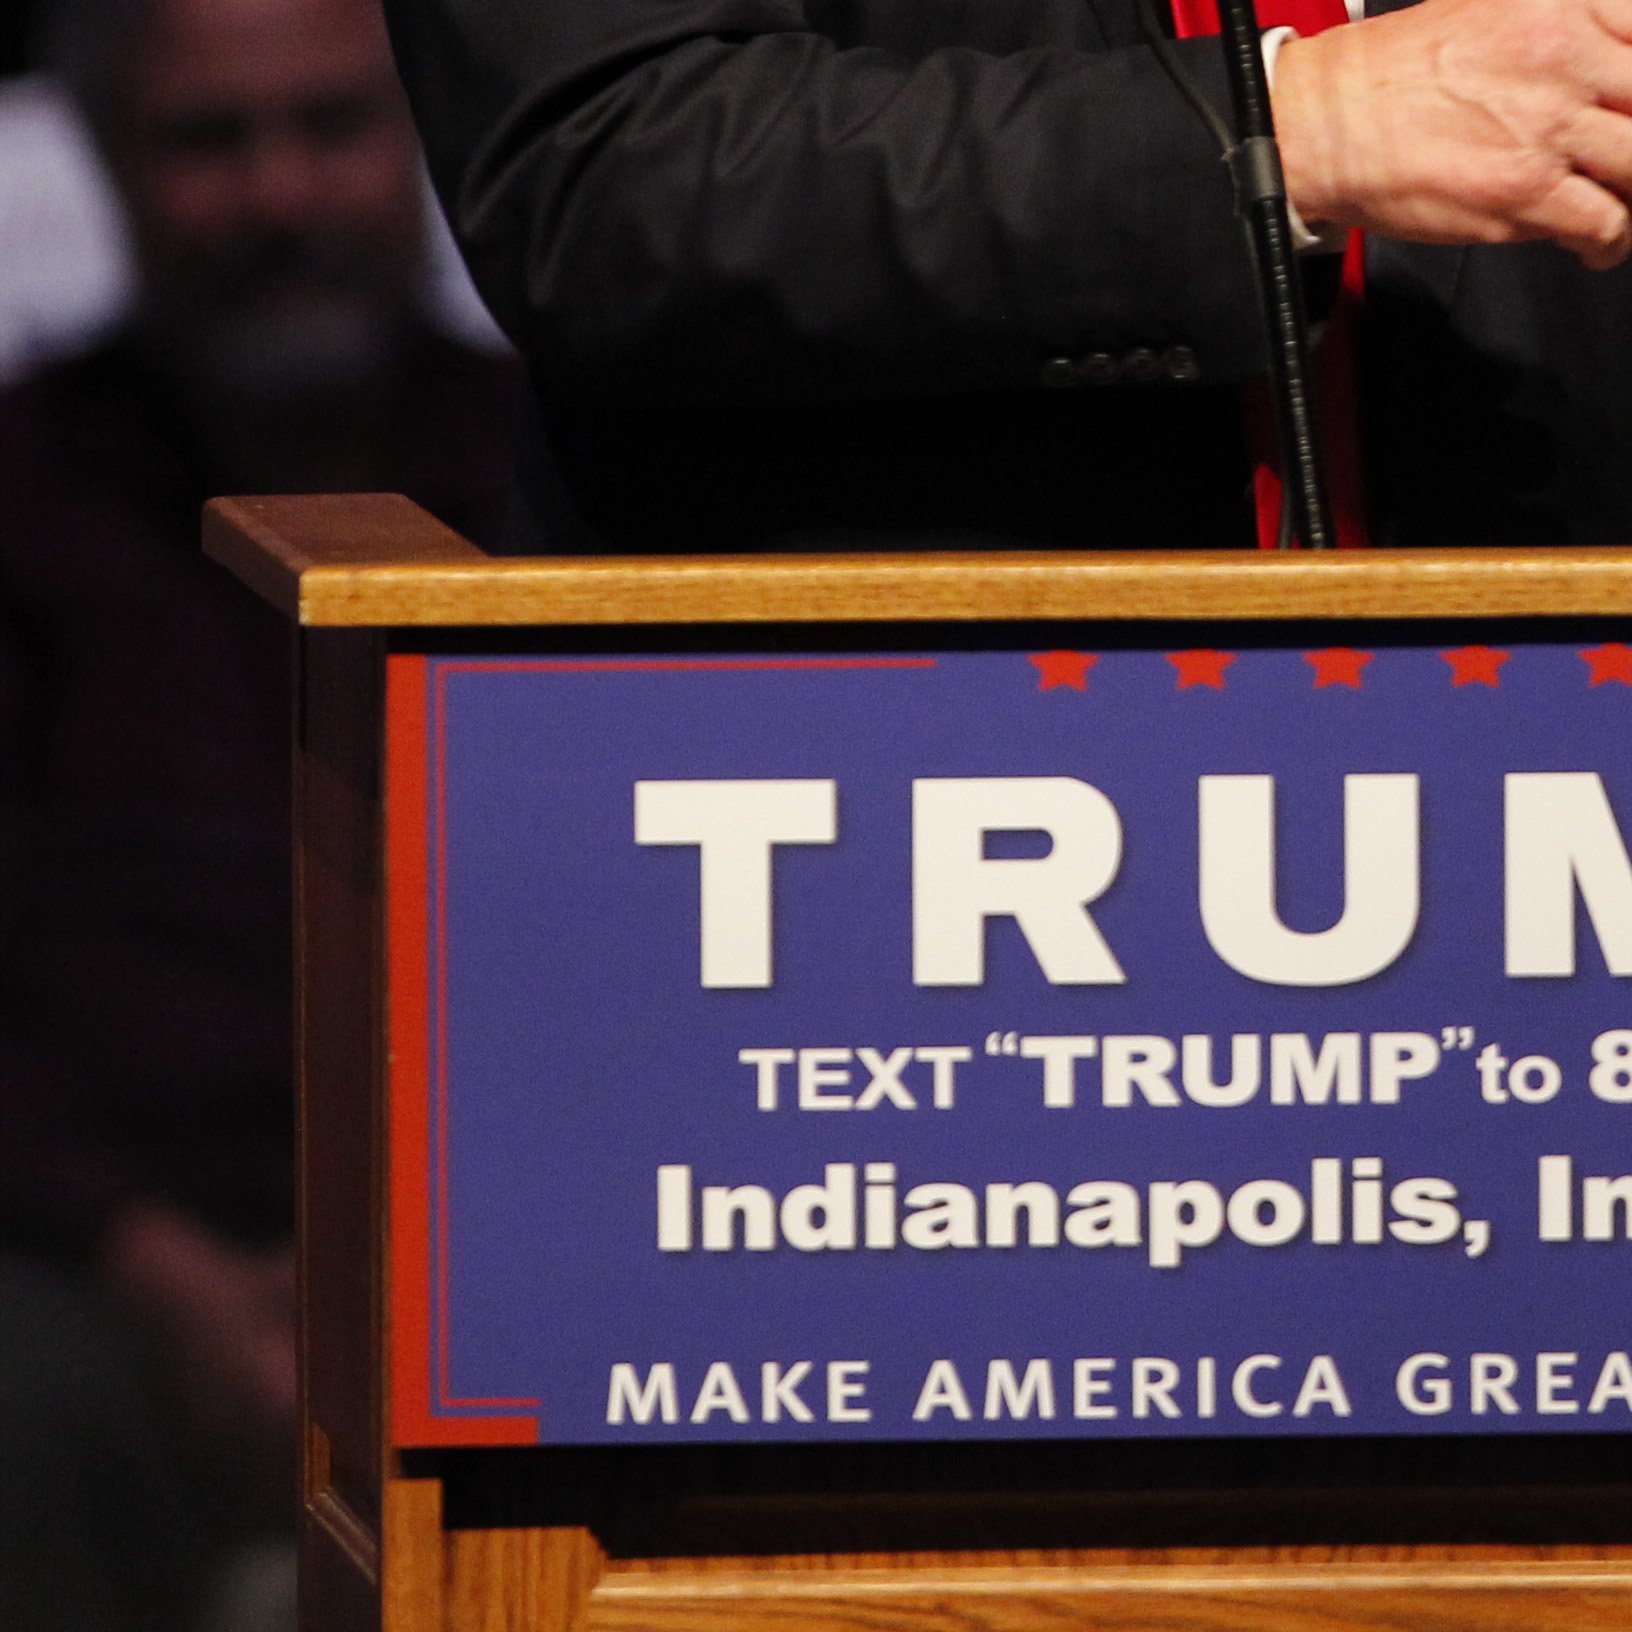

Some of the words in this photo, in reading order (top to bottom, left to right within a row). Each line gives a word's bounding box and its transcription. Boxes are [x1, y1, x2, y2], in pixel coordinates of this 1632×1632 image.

[737, 1046, 974, 1113] TEXT
[1475, 1042, 1564, 1105] to
[655, 1156, 1491, 1269] Indianapolis,
[605, 1359, 874, 1427] MAKE
[910, 1353, 1353, 1423] AMERICA
